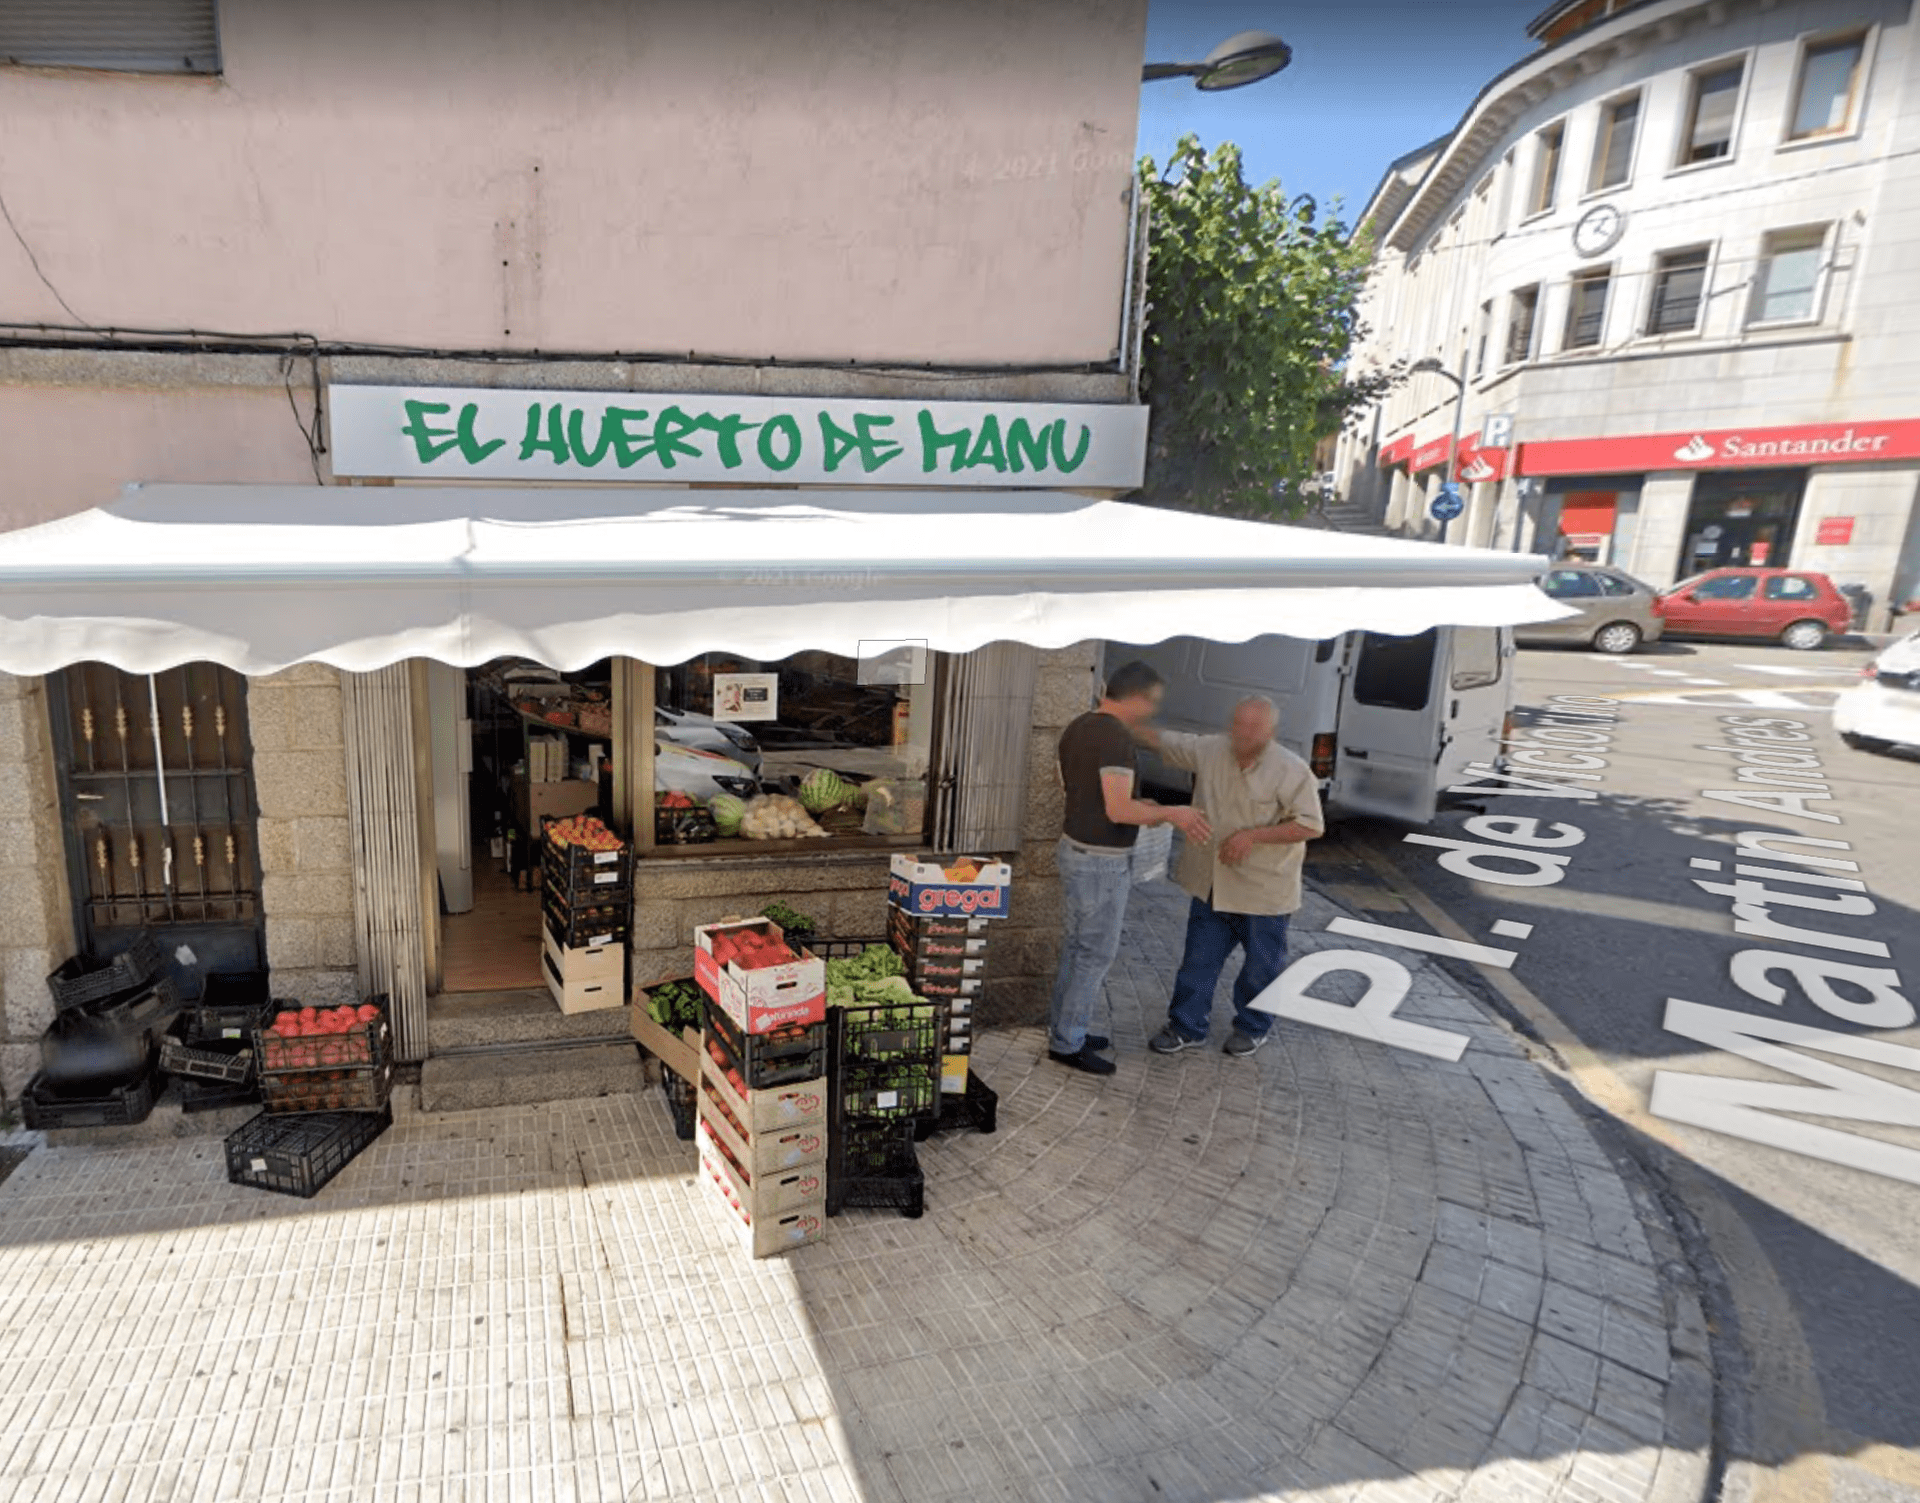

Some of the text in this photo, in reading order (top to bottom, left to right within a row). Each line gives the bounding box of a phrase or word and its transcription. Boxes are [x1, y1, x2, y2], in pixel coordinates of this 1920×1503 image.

[402, 400, 1090, 474] EL HUERTO DE MANU
[1721, 429, 1890, 457] Santander
[919, 885, 1001, 912] gregal
